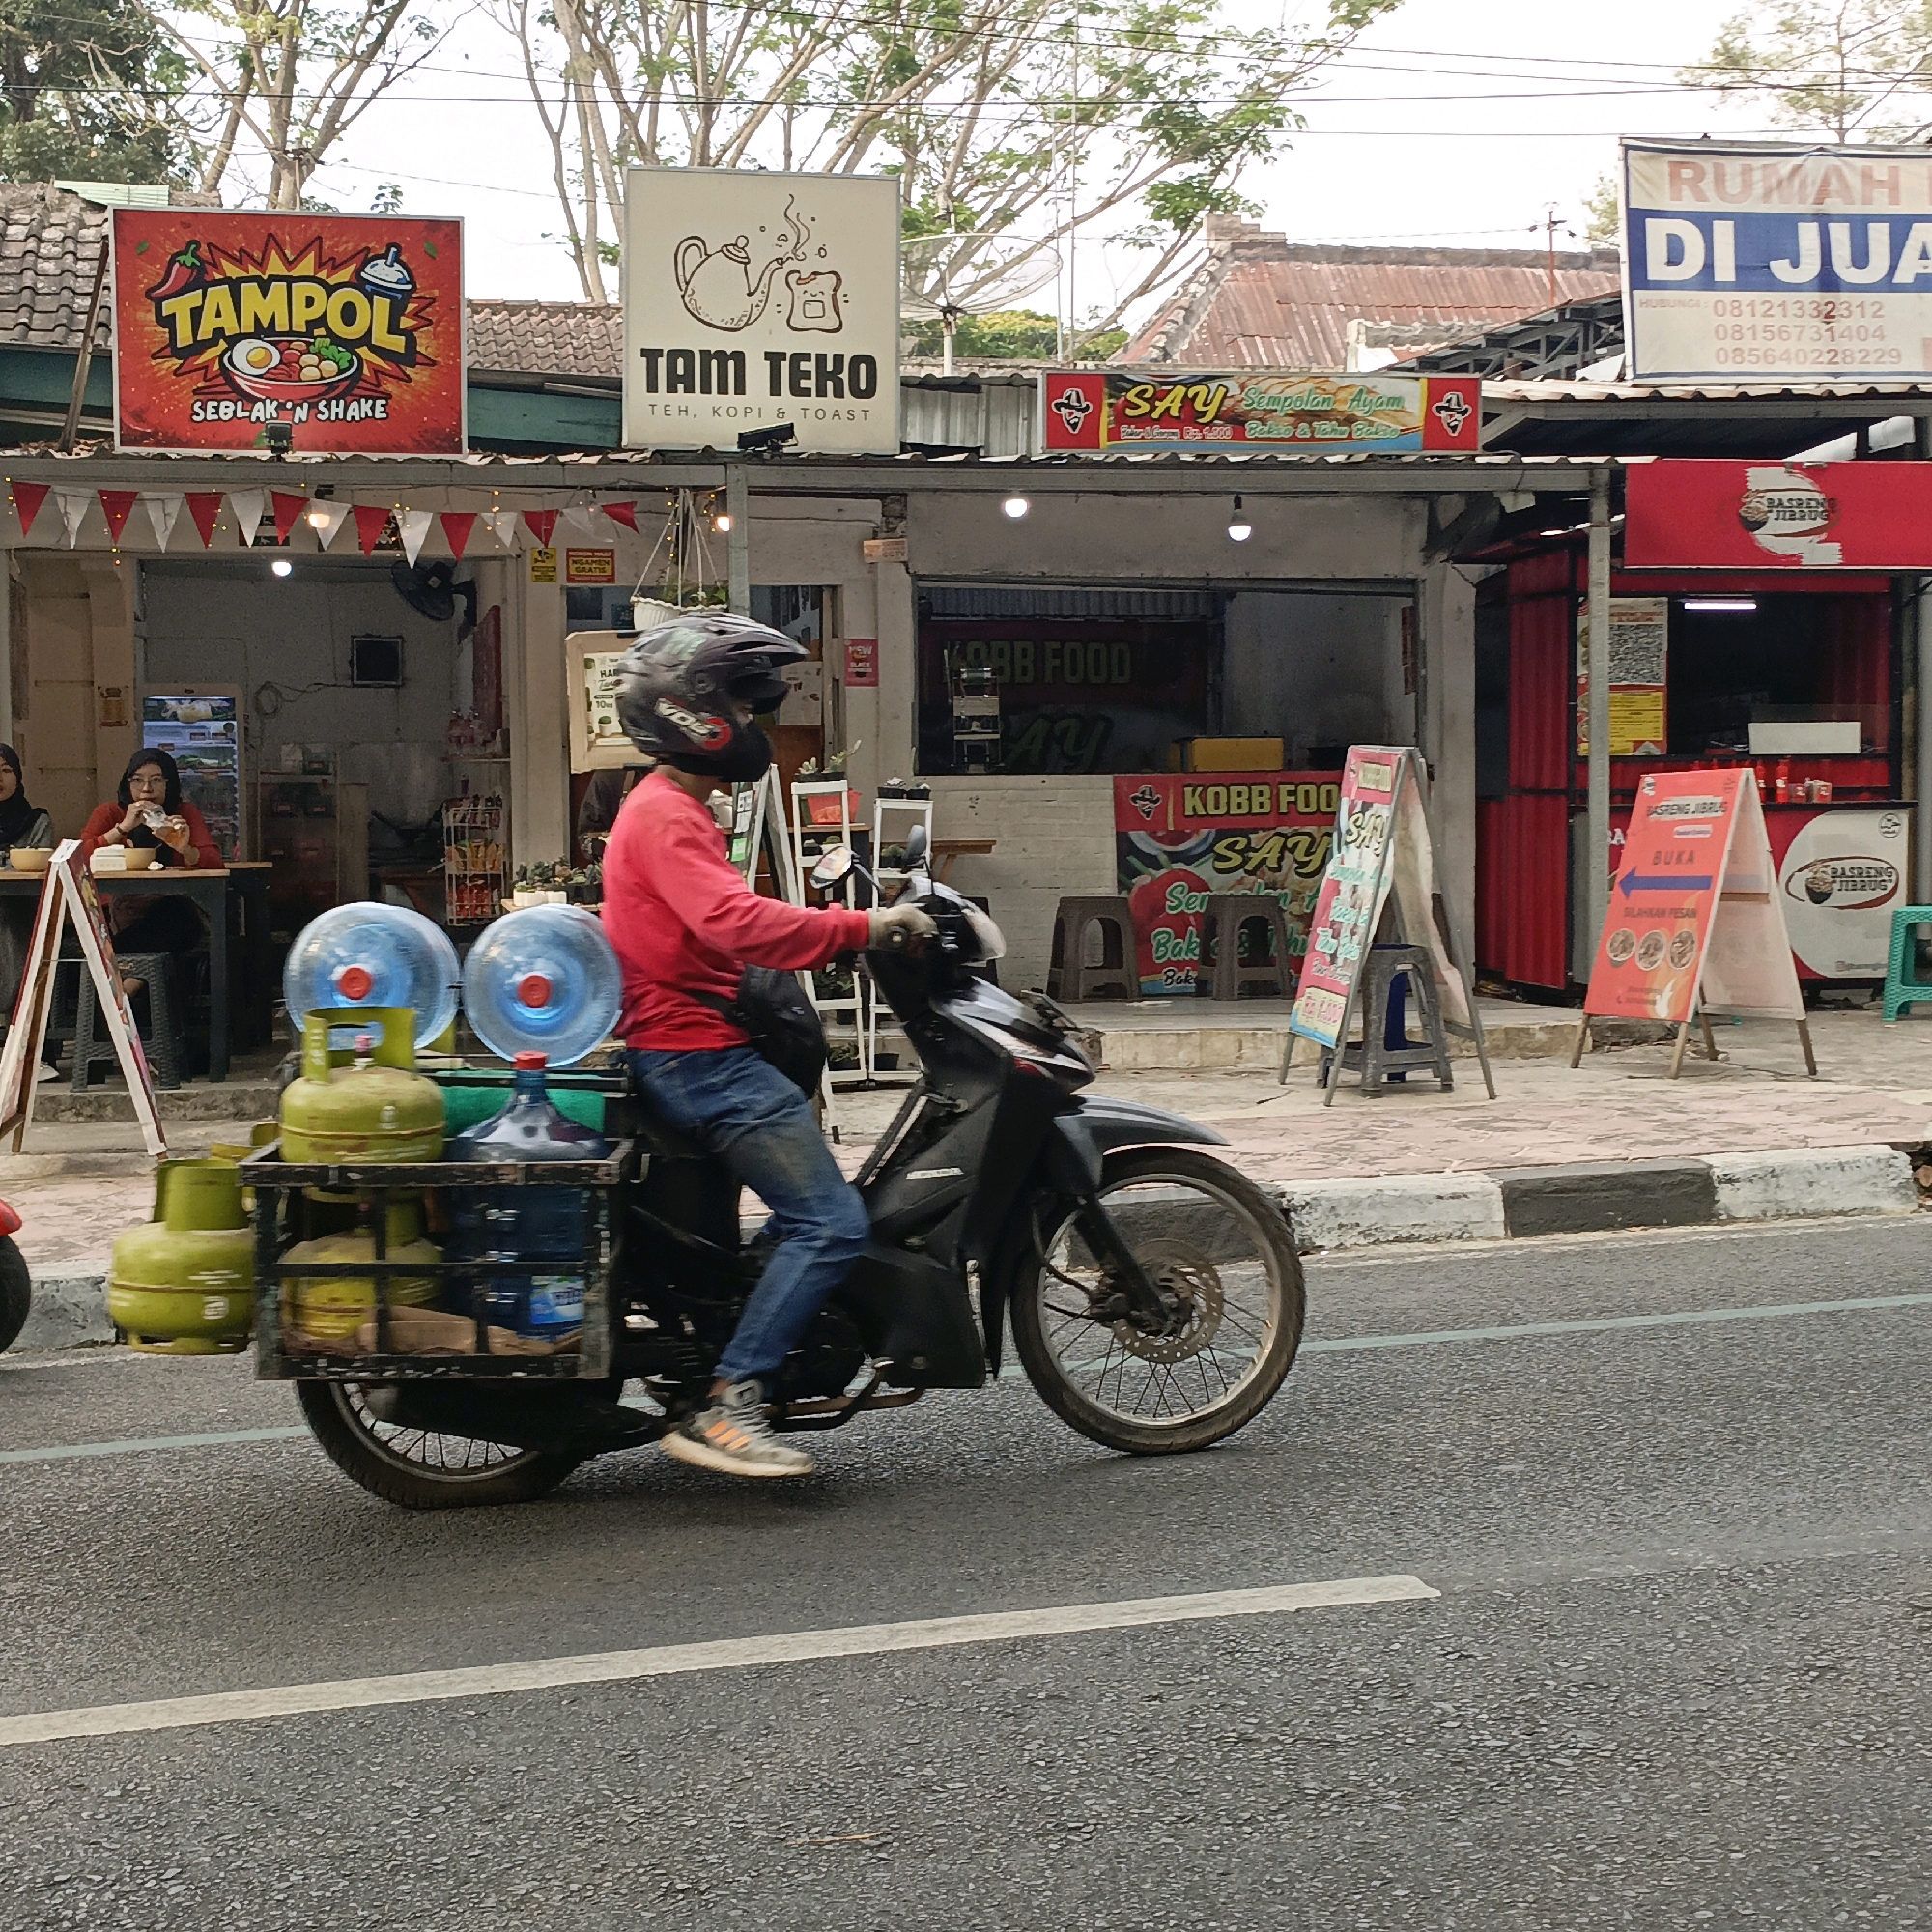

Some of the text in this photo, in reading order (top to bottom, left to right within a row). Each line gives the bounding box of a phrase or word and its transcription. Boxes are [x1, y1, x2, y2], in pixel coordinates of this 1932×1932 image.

[1668, 161, 1901, 206] RUMAH
[1645, 218, 1736, 282] DI
[161, 281, 407, 355] TAMPOL
[1638, 298, 1701, 309] HUBUNGI
[1713, 299, 1885, 320] 08121332312
[1714, 324, 1888, 343] 08156731404
[1715, 347, 1903, 366] 085640228229
[640, 348, 878, 400] TAM TEKO
[191, 399, 278, 422] SEBLAK
[317, 398, 388, 422] SHAKE
[648, 404, 870, 421] TEH, KOPI & TOAST
[1124, 384, 1227, 423] SAY
[1242, 386, 1406, 416] Sempolan Ayam
[1295, 423, 1311, 438] &
[1044, 641, 1130, 684] FOOD
[1183, 781, 1341, 818] KOBB FOO
[1210, 833, 1333, 877] SAY
[1653, 850, 1696, 866] BUKA
